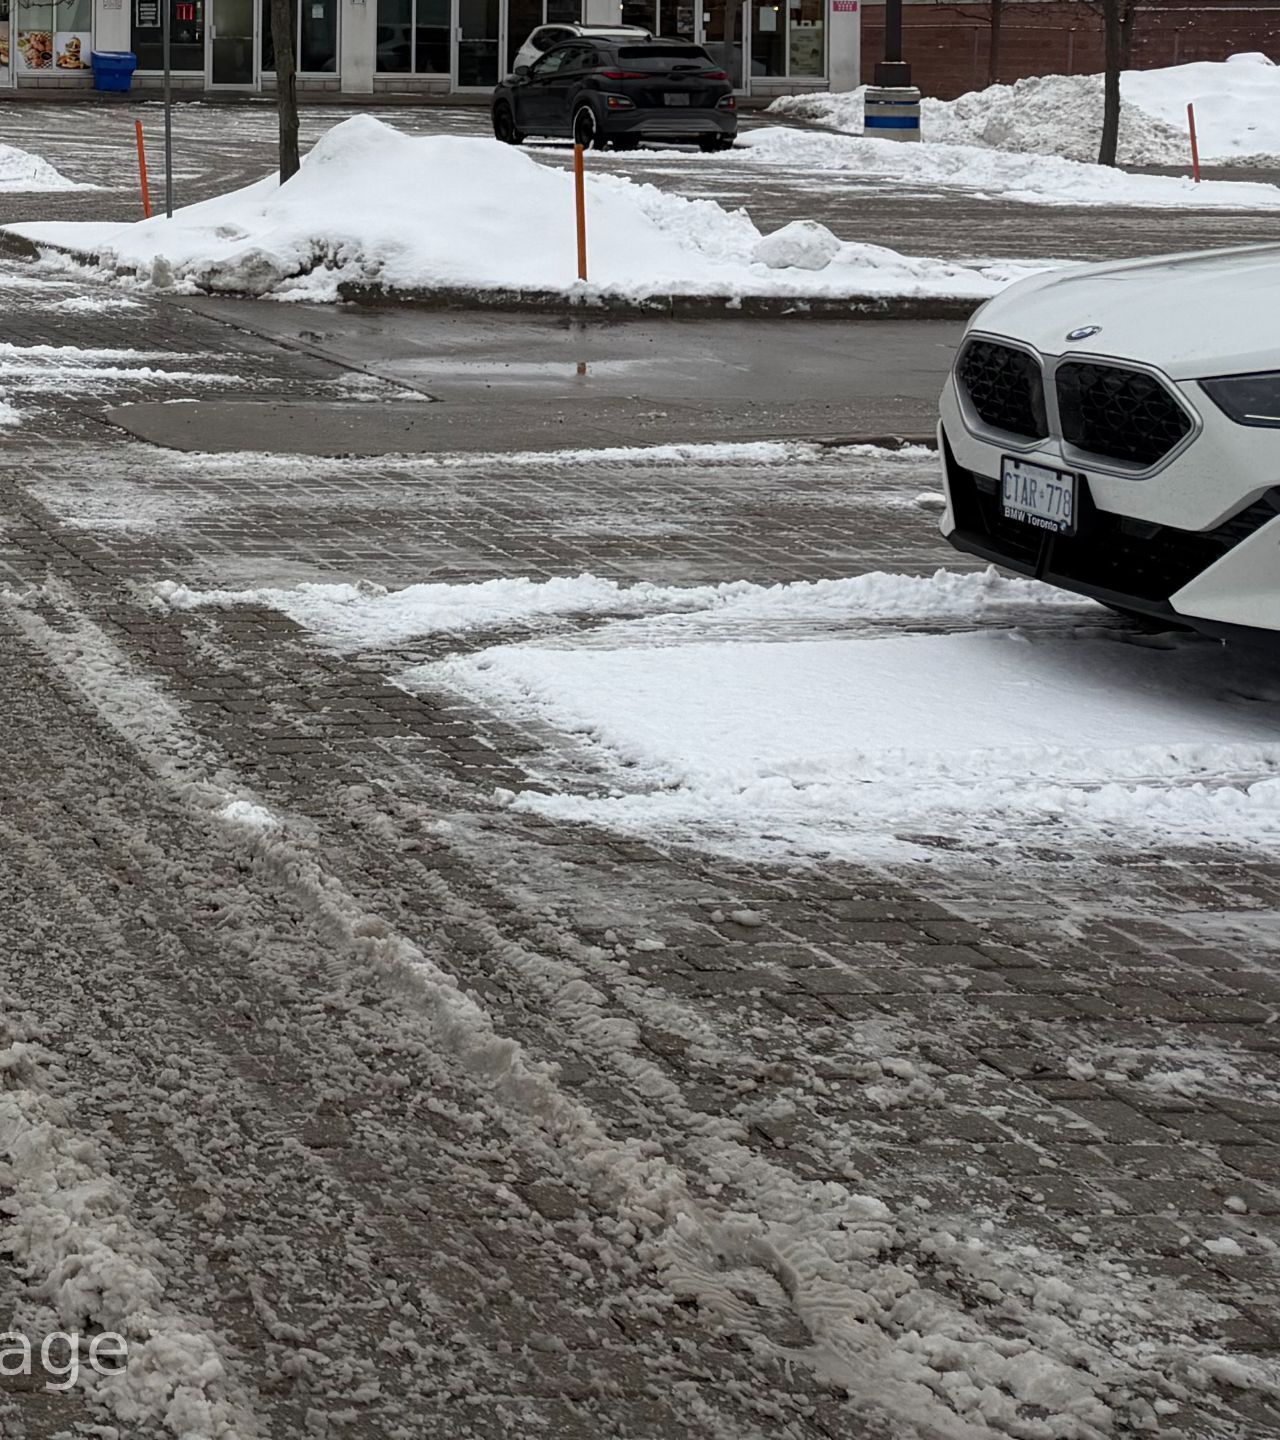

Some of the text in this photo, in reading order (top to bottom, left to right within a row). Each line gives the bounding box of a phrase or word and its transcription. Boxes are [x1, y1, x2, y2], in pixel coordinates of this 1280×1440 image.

[1004, 472, 1072, 517] CTAR 778
[1004, 506, 1058, 532] BMW Toronto
